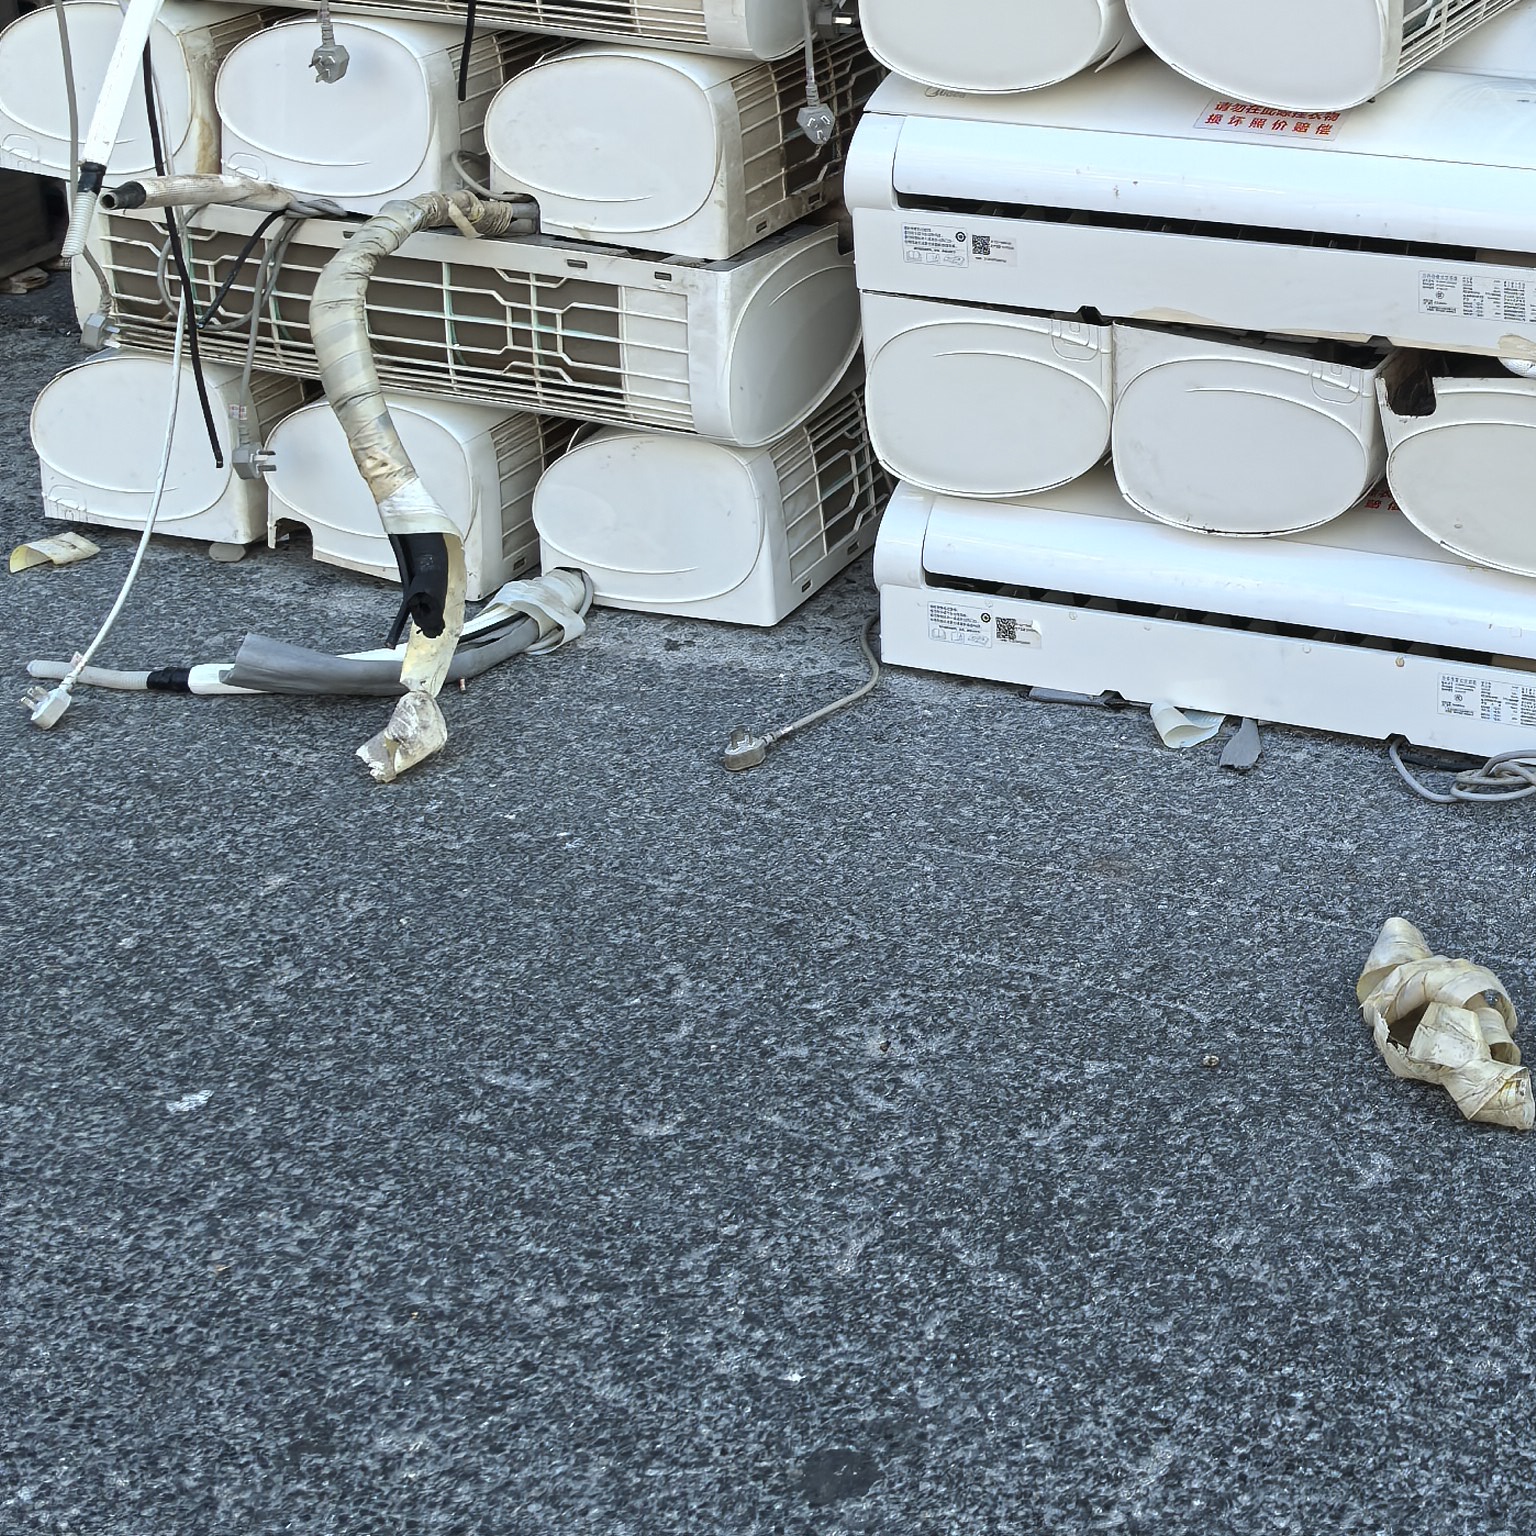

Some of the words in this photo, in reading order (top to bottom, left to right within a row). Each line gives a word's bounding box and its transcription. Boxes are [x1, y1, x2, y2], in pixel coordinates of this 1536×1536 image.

[1205, 113, 1334, 136] 损坏照价赔偿
